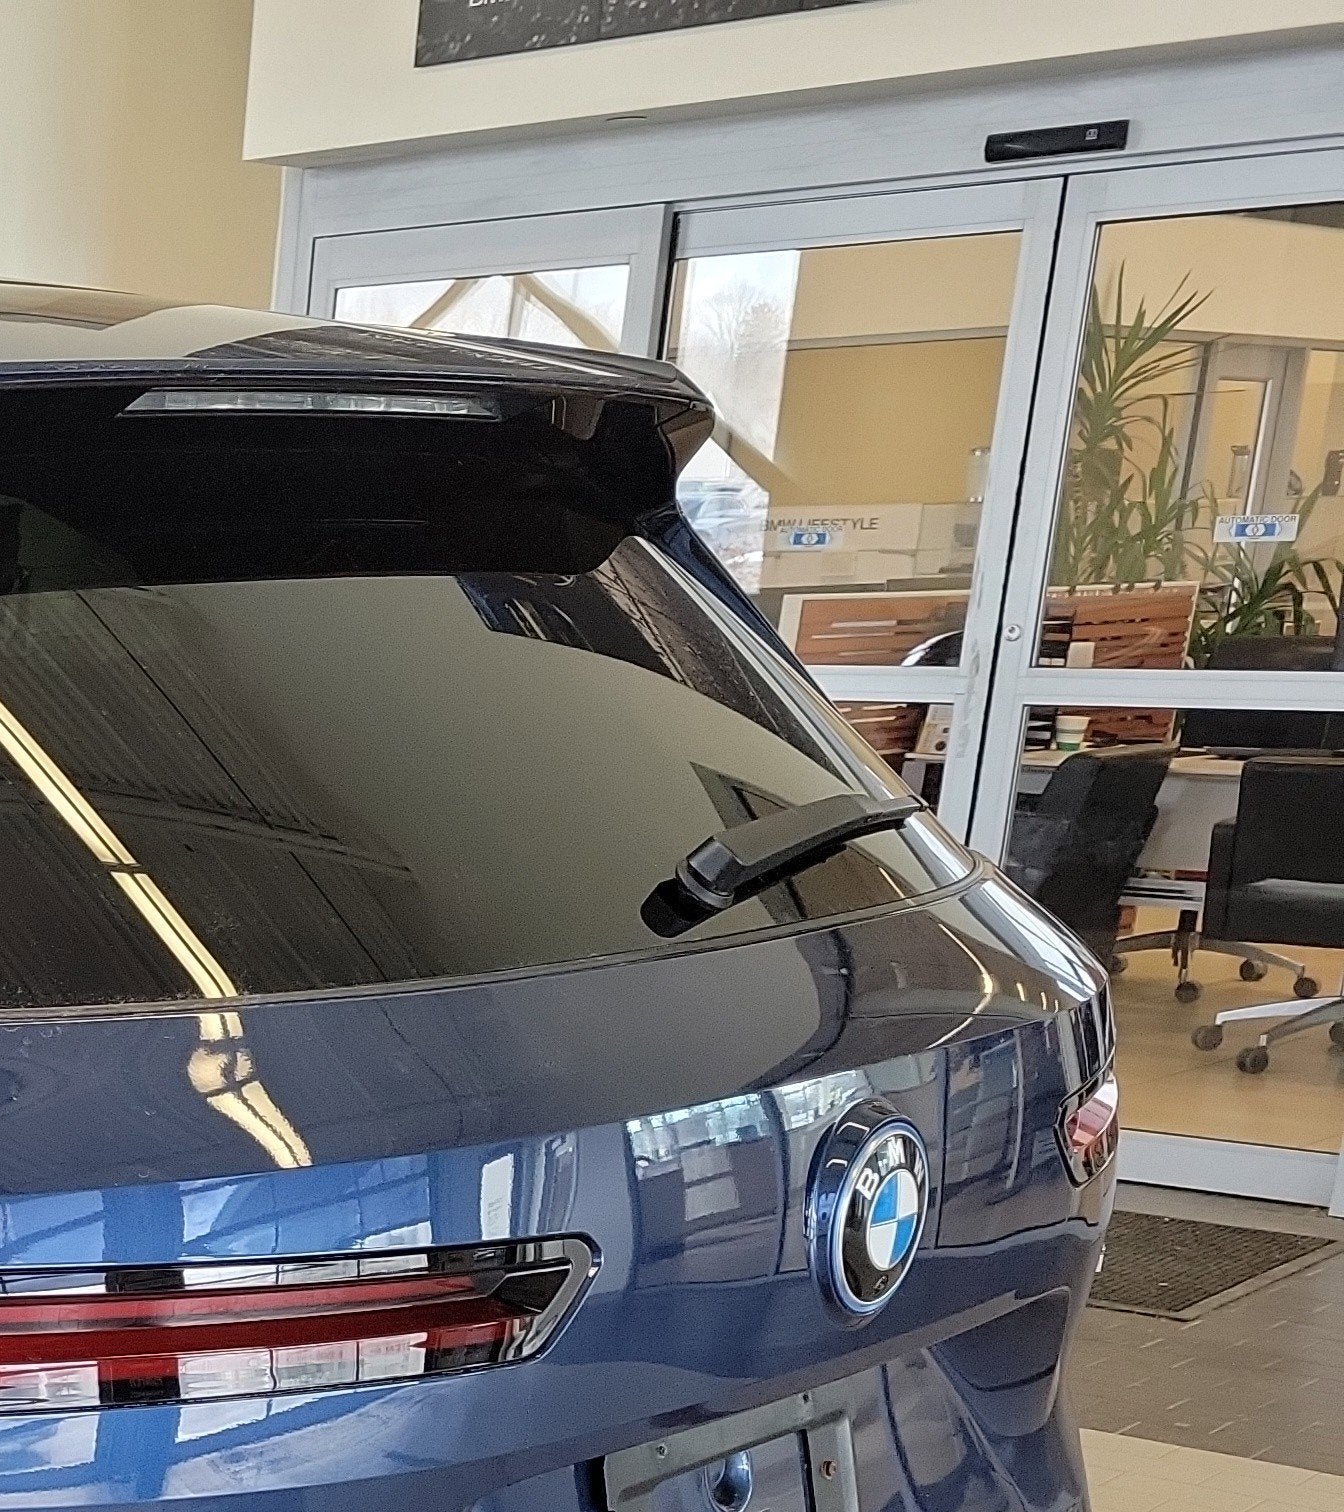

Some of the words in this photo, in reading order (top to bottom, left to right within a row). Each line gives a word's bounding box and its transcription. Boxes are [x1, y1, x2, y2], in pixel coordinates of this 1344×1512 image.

[760, 518, 797, 532] BMW
[1219, 515, 1270, 524] AUTOMATIC
[1271, 515, 1297, 523] DOOR
[855, 1136, 925, 1201] BMW
